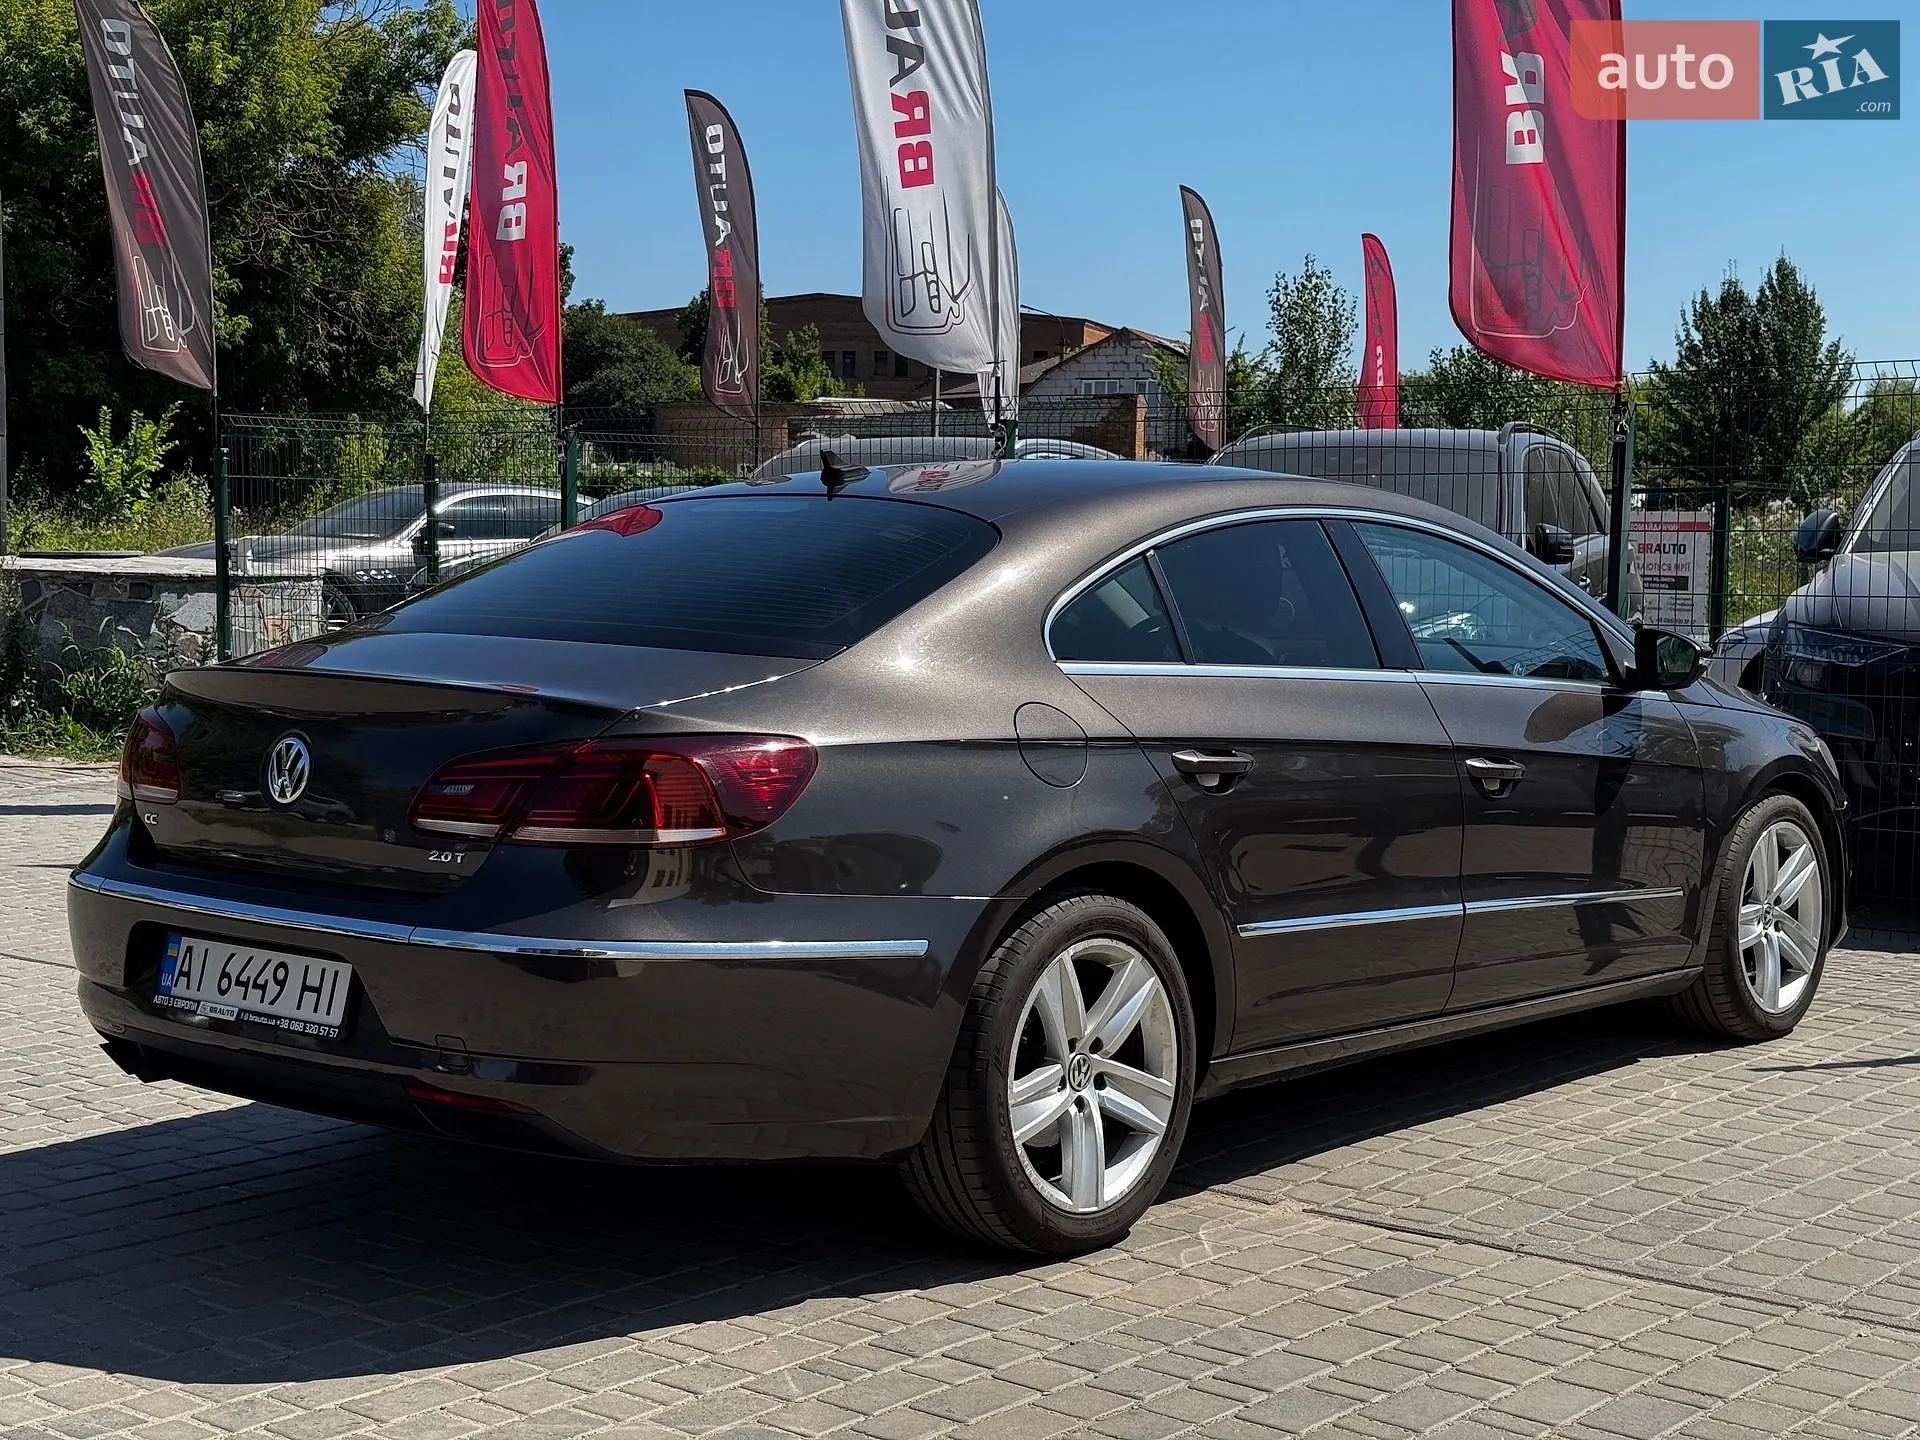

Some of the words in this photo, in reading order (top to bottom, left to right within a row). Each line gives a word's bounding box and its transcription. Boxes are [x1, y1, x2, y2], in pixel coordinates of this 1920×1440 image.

[1638, 543, 1686, 554] BRAUTO
[144, 813, 159, 825] CC
[161, 973, 172, 987] UA
[174, 946, 209, 992] AI
[217, 952, 290, 1006] 6449
[296, 965, 339, 1016] HI
[209, 1006, 235, 1017] BRAUTO
[276, 1018, 290, 1029] +38
[304, 1023, 319, 1034] 320
[319, 1026, 329, 1037] 57
[328, 1028, 339, 1038] 57
